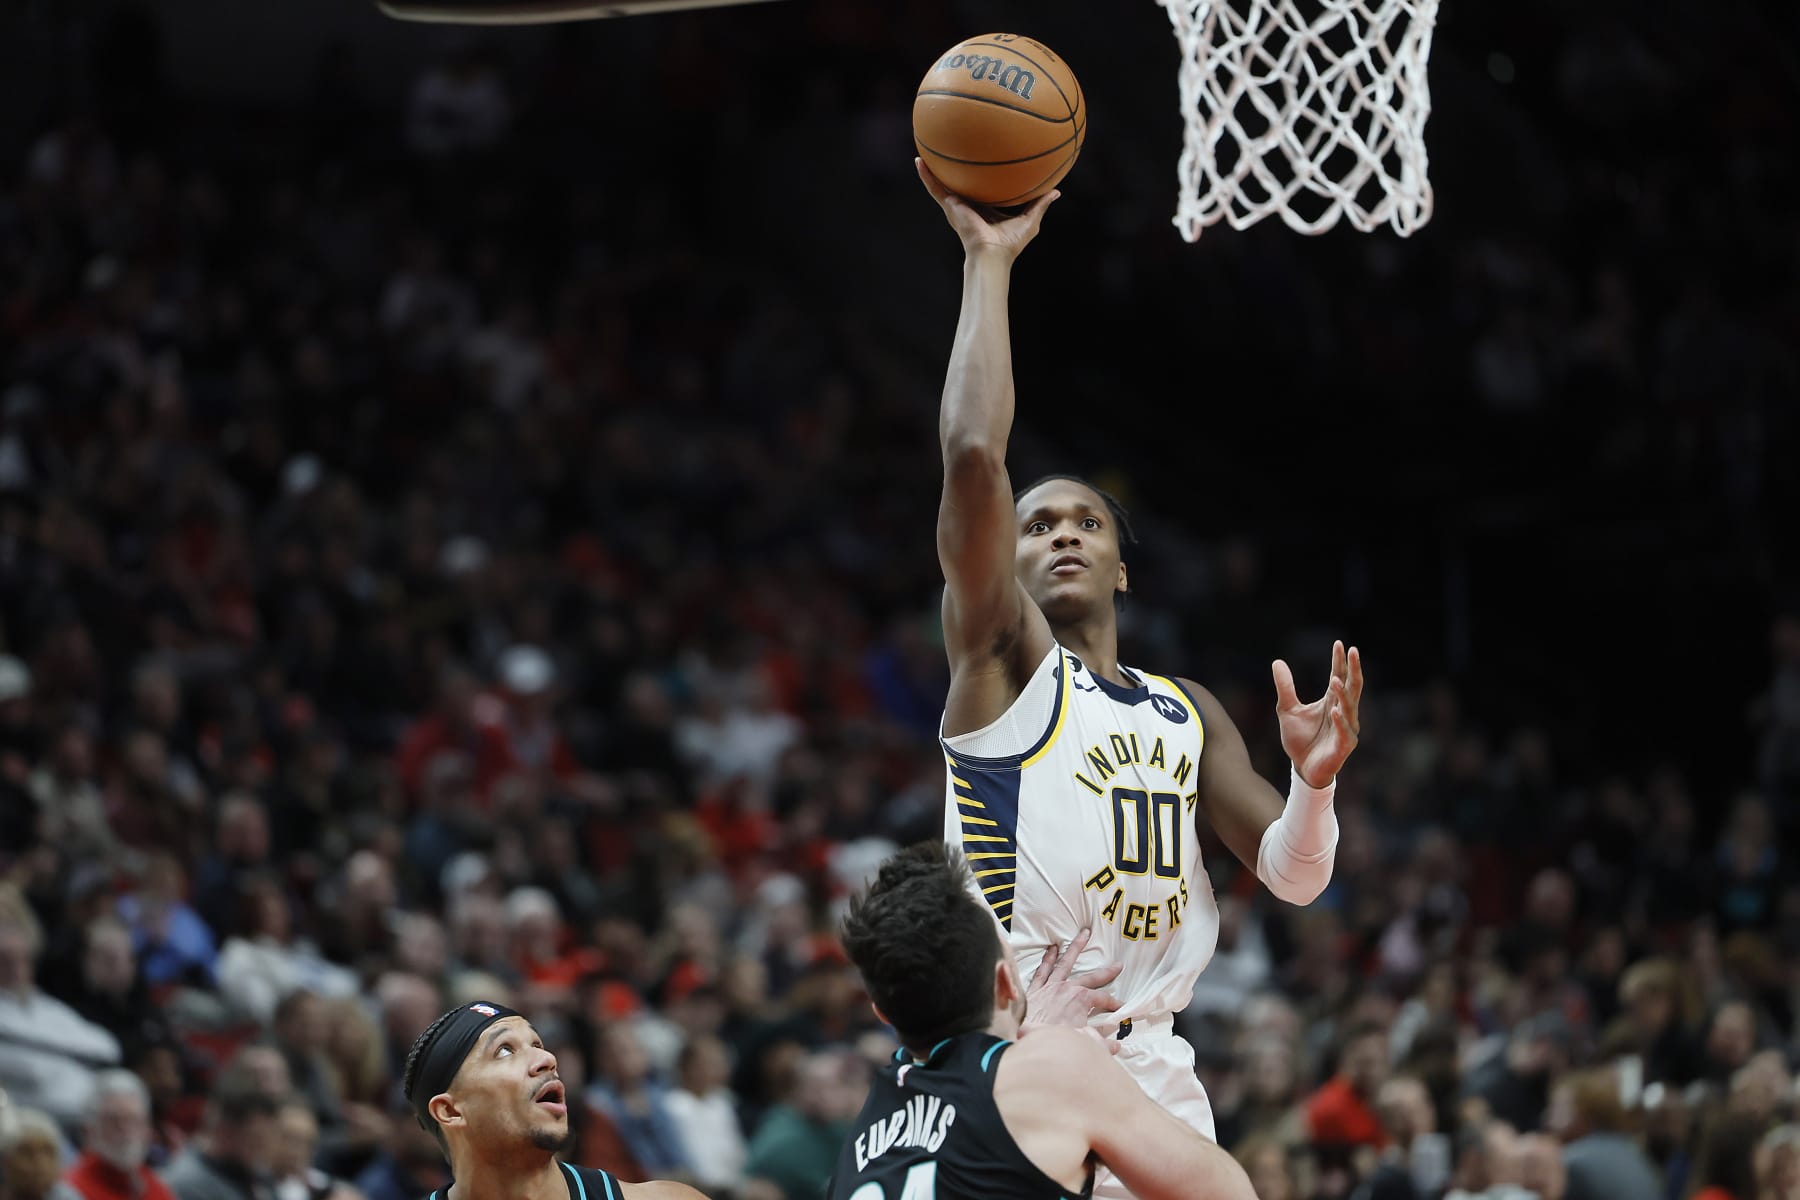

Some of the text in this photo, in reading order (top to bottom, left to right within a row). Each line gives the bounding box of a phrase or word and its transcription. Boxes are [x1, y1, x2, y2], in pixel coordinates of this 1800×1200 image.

[1073, 732, 1198, 818] INDIANA
[1111, 786, 1181, 879] 00
[1084, 864, 1189, 940] PACERS
